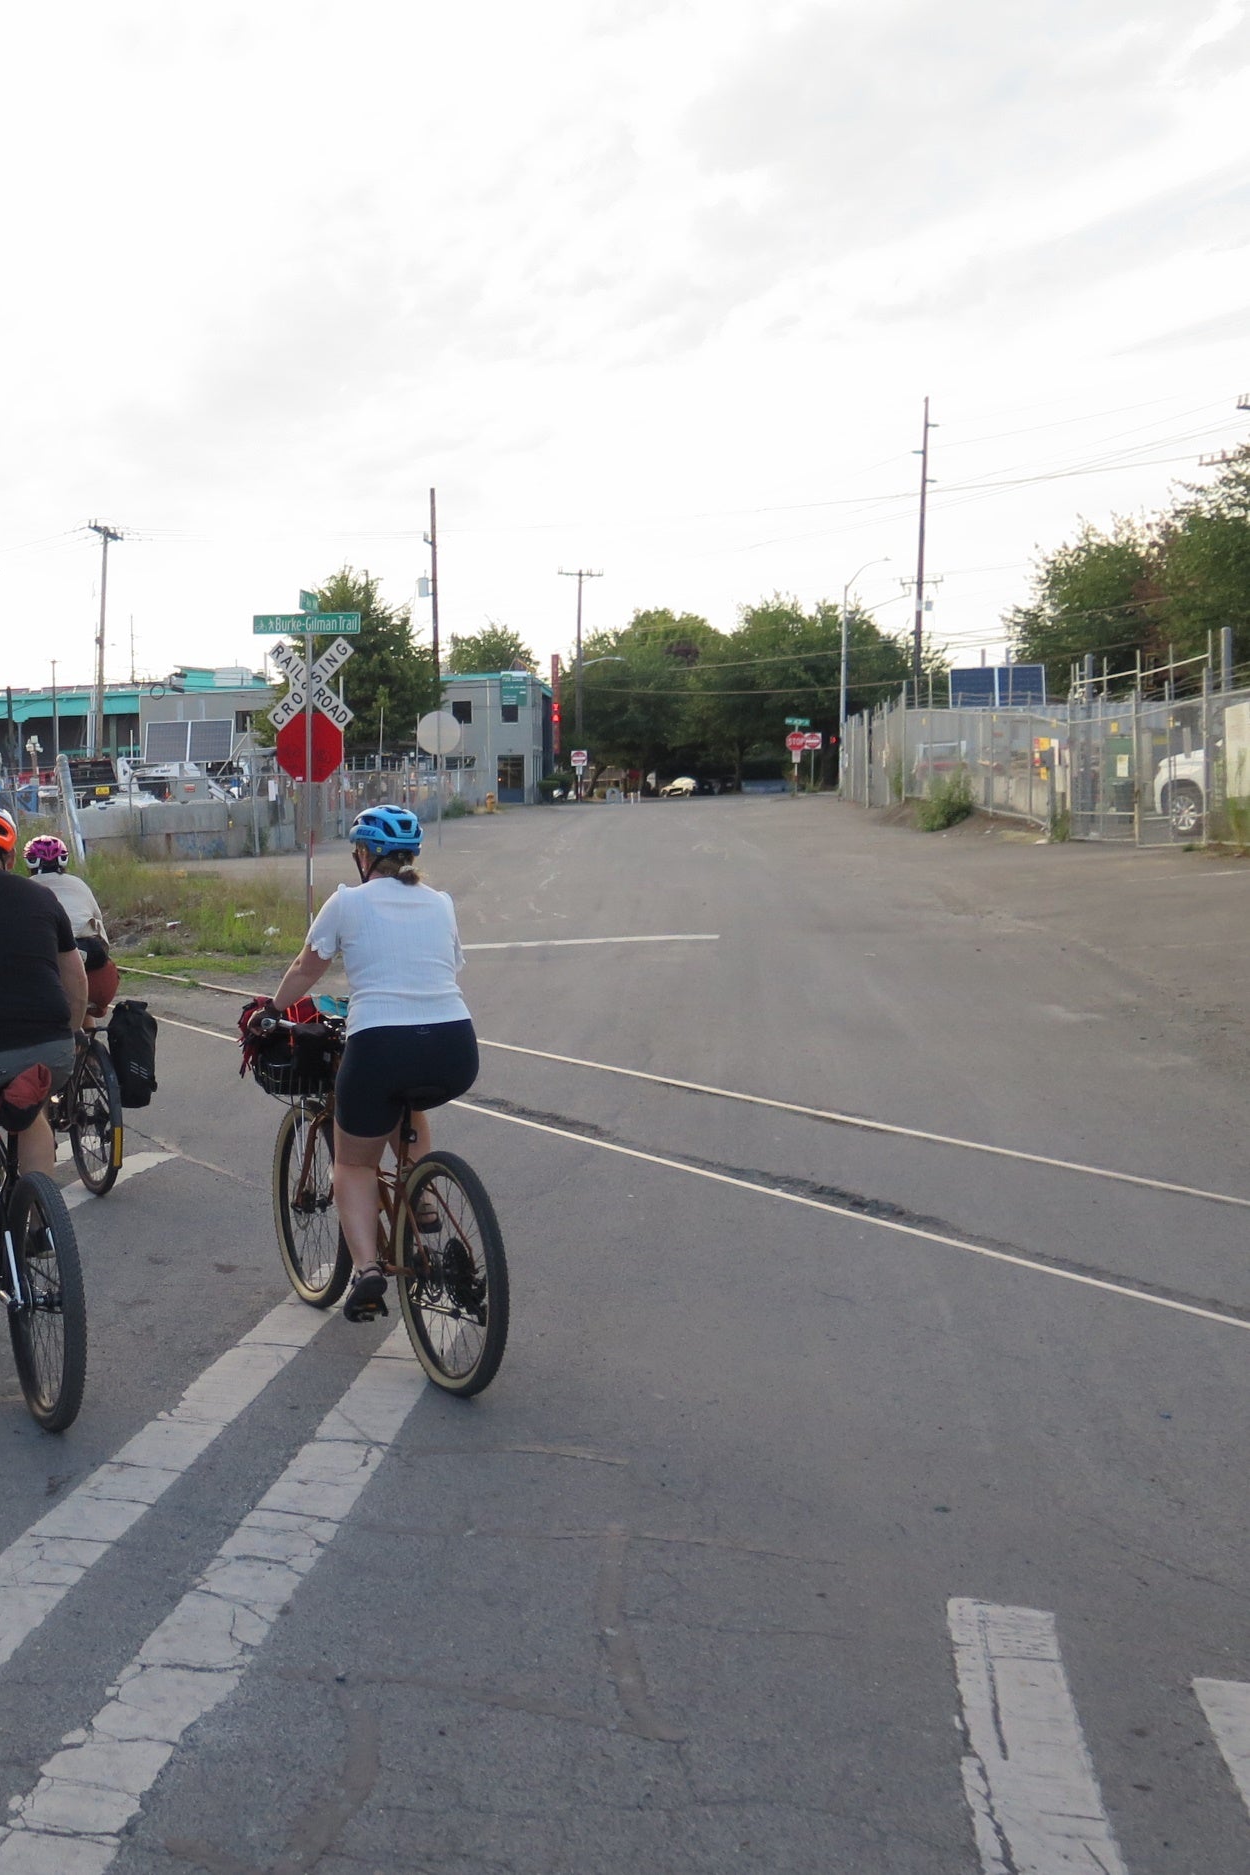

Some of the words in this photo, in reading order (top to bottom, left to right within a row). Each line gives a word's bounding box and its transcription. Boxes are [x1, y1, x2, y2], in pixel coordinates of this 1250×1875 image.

[275, 616, 337, 632] Burke-Gilman
[338, 615, 358, 631] Trail
[272, 644, 304, 682] RAIL
[312, 688, 349, 724] ROAD
[788, 737, 804, 746] STOP
